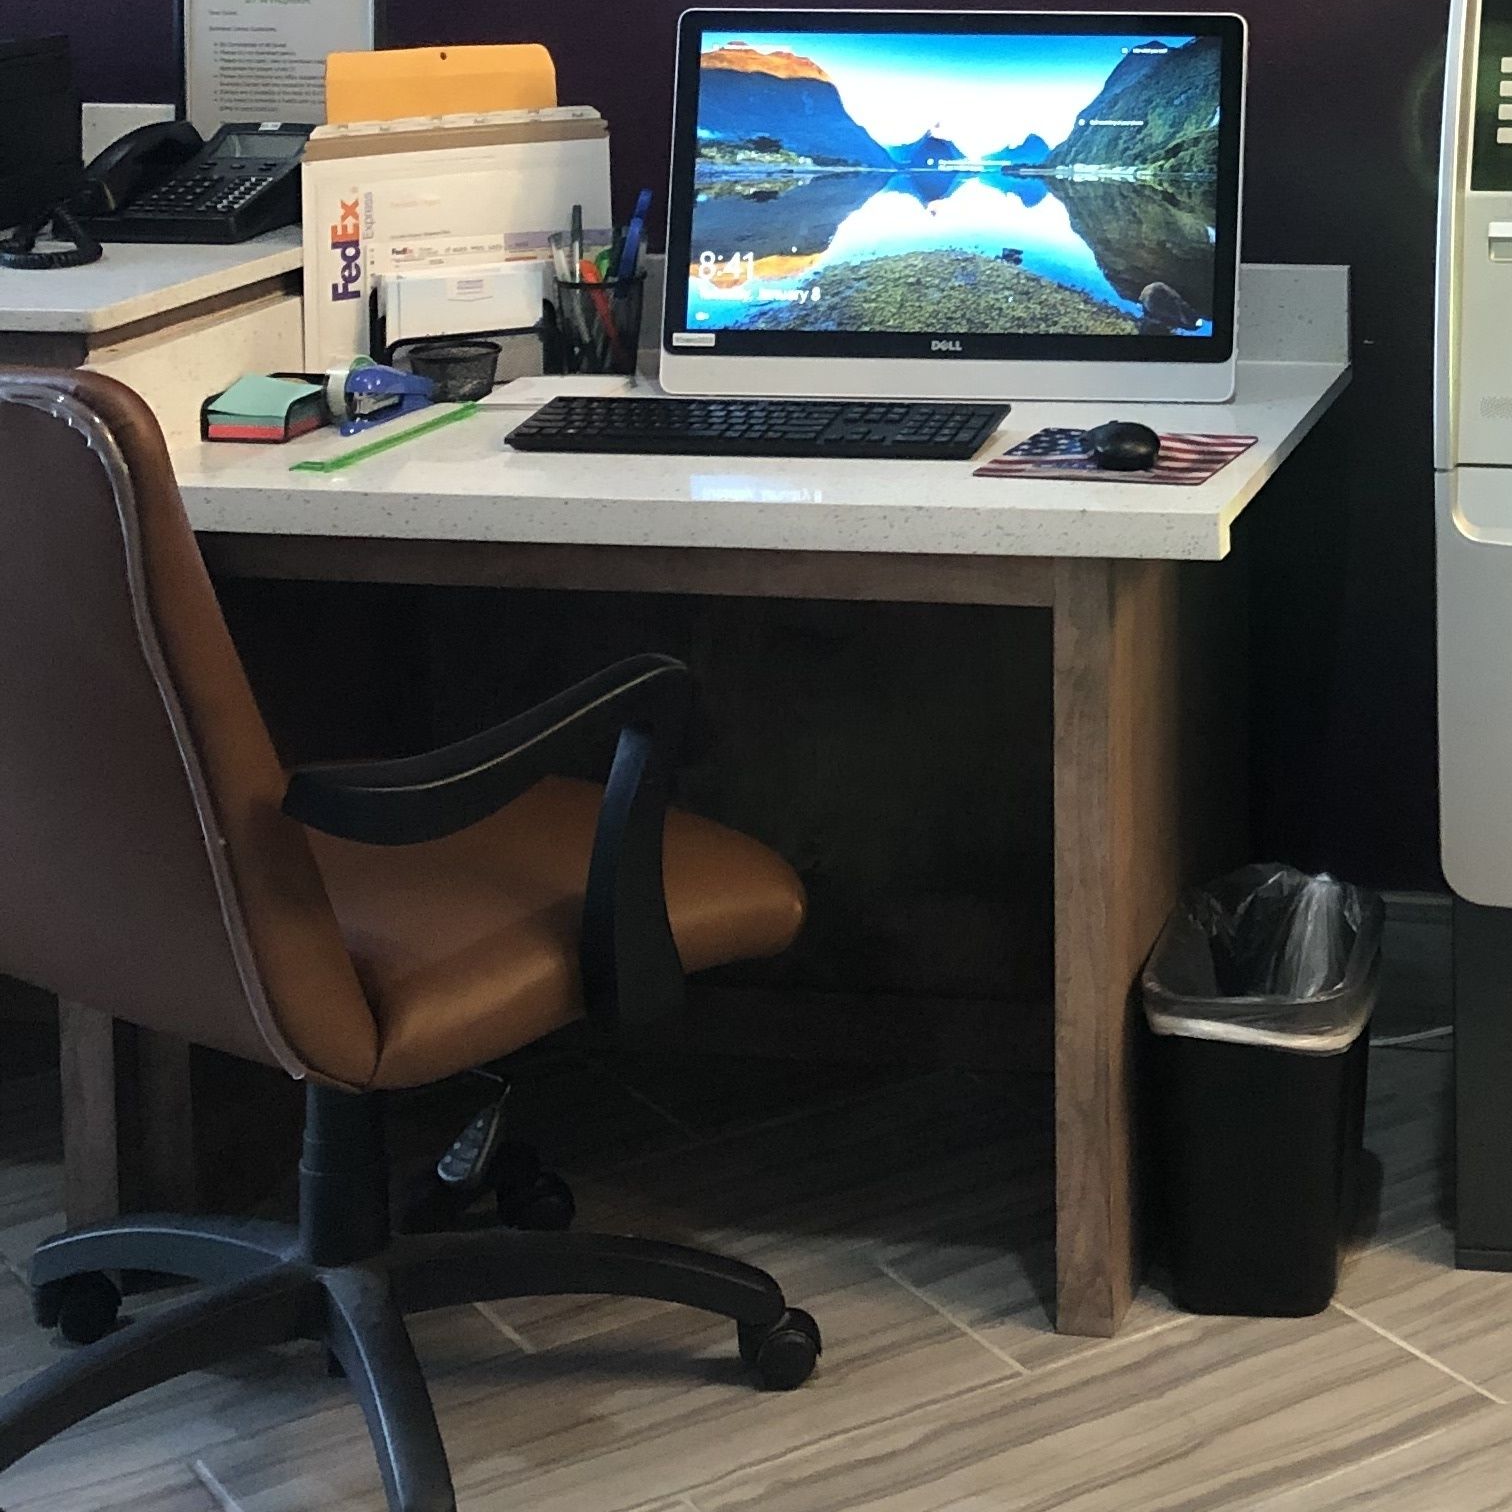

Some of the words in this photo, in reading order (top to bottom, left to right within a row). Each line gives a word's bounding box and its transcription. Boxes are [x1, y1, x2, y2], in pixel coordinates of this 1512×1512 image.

[363, 191, 376, 240] Express
[331, 199, 362, 302] FedEx
[698, 250, 755, 281] 8:41
[811, 286, 821, 302] 8
[931, 340, 963, 351] DELL
